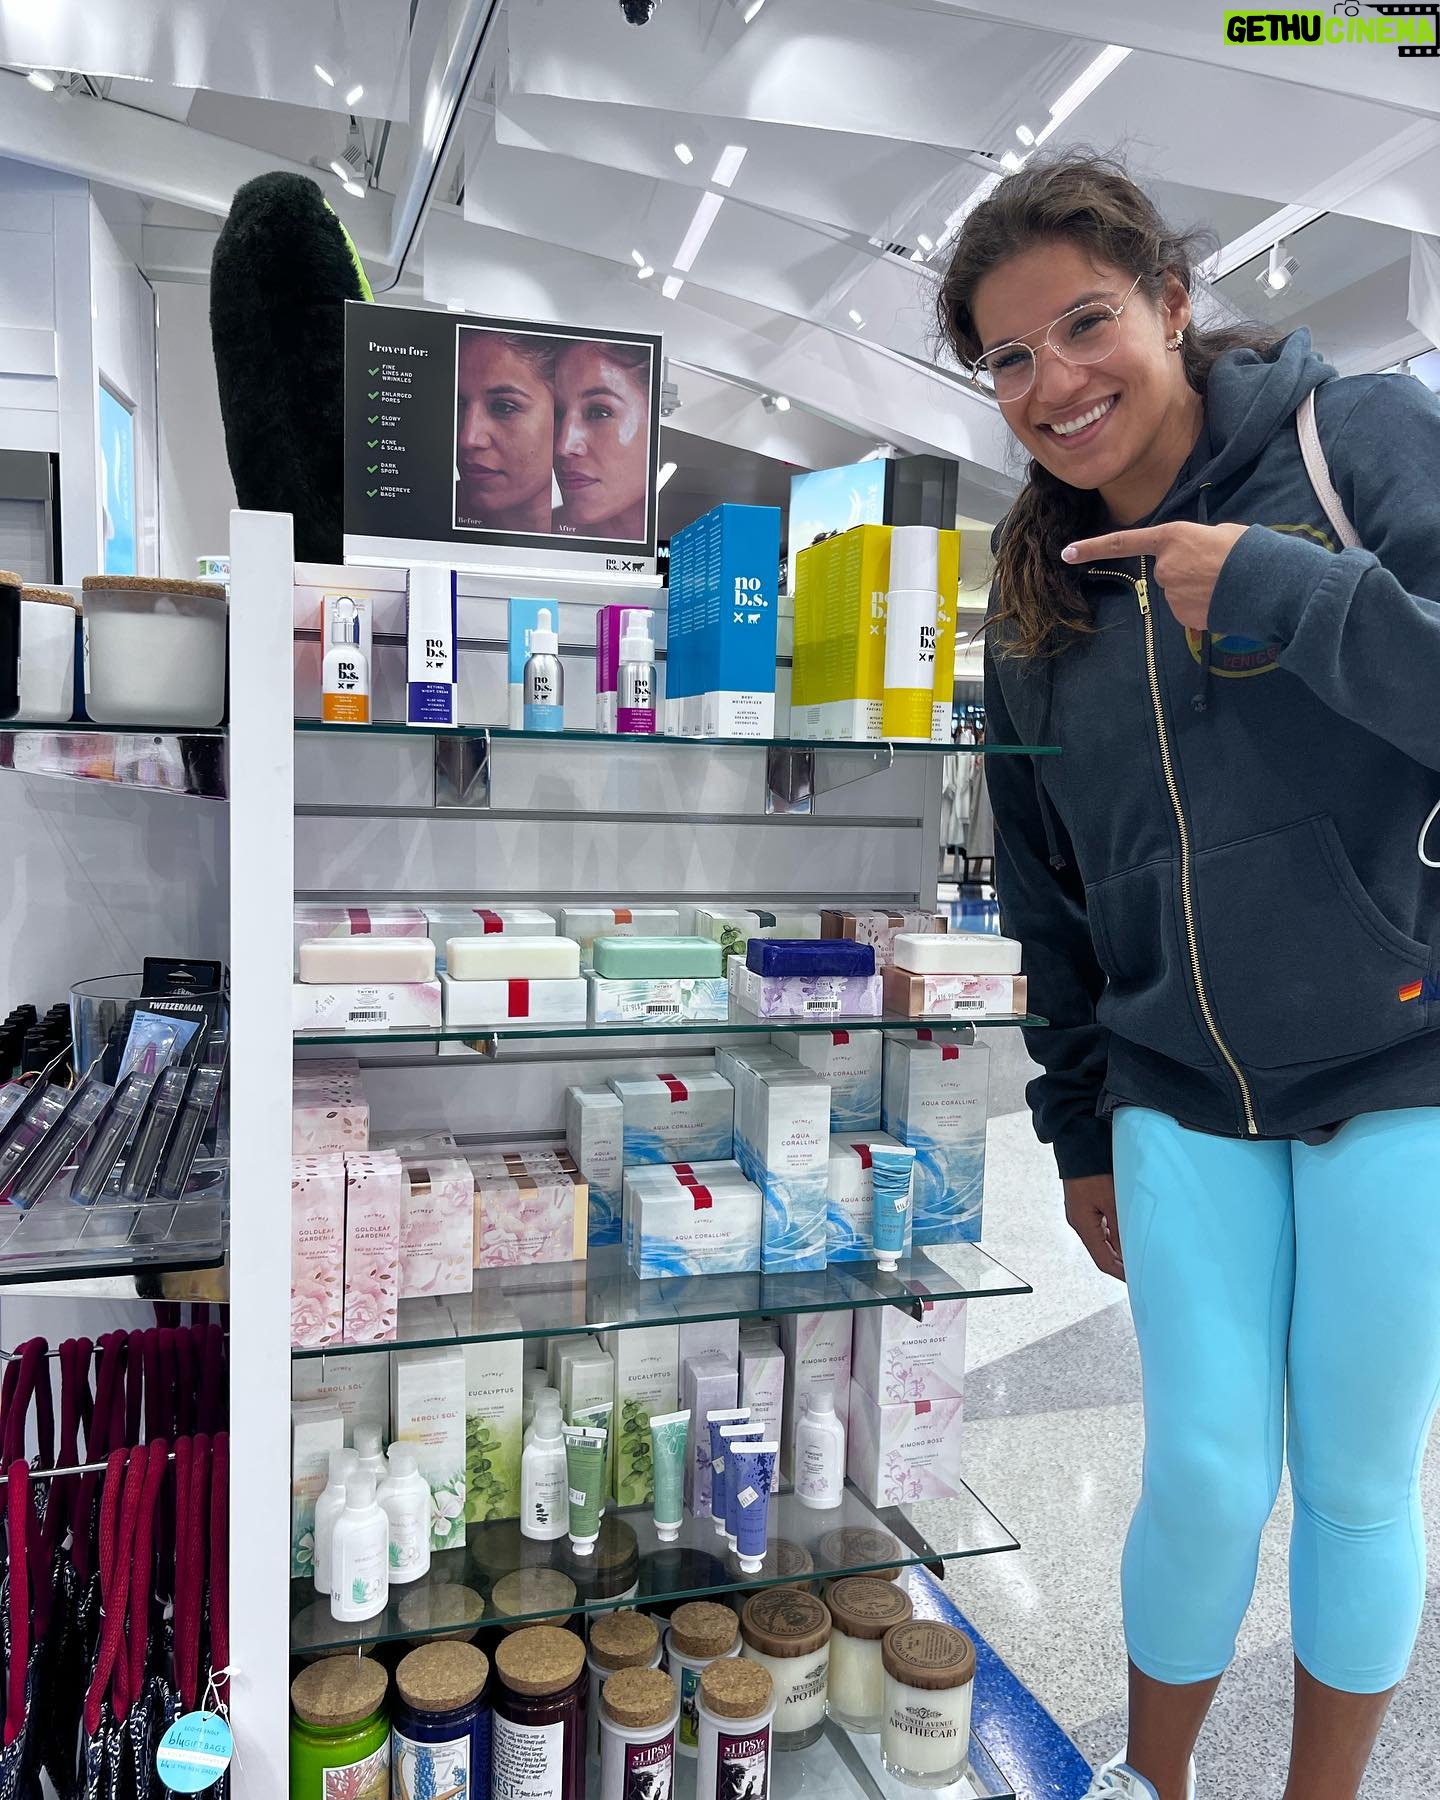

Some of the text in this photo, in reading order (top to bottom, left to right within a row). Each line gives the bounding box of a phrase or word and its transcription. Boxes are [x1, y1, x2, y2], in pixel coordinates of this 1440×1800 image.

[369, 341, 428, 357] Proven for:
[381, 391, 412, 399] ENLARGED
[380, 486, 411, 494] UNDEREYE
[458, 516, 483, 526] Before
[558, 525, 576, 533] After
[734, 576, 761, 590] no
[734, 590, 769, 607] b.s.
[426, 639, 443, 648] no
[426, 647, 448, 659] b.s.
[338, 662, 355, 671] no
[338, 670, 359, 681] b.s.
[533, 676, 548, 684] no
[533, 683, 553, 692] b.s.
[634, 679, 648, 687] no
[634, 686, 652, 695] b.s.
[149, 1001, 204, 1012] TWEEZERMAN
[671, 1122, 705, 1130] CORALLINE
[781, 1139, 819, 1147] CORALLINE
[298, 1227, 335, 1236] GOLDLEAF
[355, 1224, 391, 1233] GOLDLEAF
[298, 1234, 336, 1244] GARDENIA
[355, 1232, 391, 1240] GARDENIA
[694, 1231, 730, 1239] CORALLINE
[902, 1338, 928, 1346] KIMONO
[628, 1371, 671, 1381] EUCALYPTUS
[347, 1383, 362, 1391] SOL
[468, 1387, 514, 1397] EUCALYPTUS
[411, 1414, 439, 1423] NEROLI
[900, 1437, 944, 1449] KIMONO ROSE
[792, 1679, 822, 1691] SEVENTH
[893, 1709, 953, 1728] SEVENTH AVENUE
[889, 1716, 960, 1739] APOTHECARY
[204, 1743, 227, 1754] BAGS
[731, 1738, 762, 1754] TIPSY
[639, 1743, 669, 1761] TIPSY
